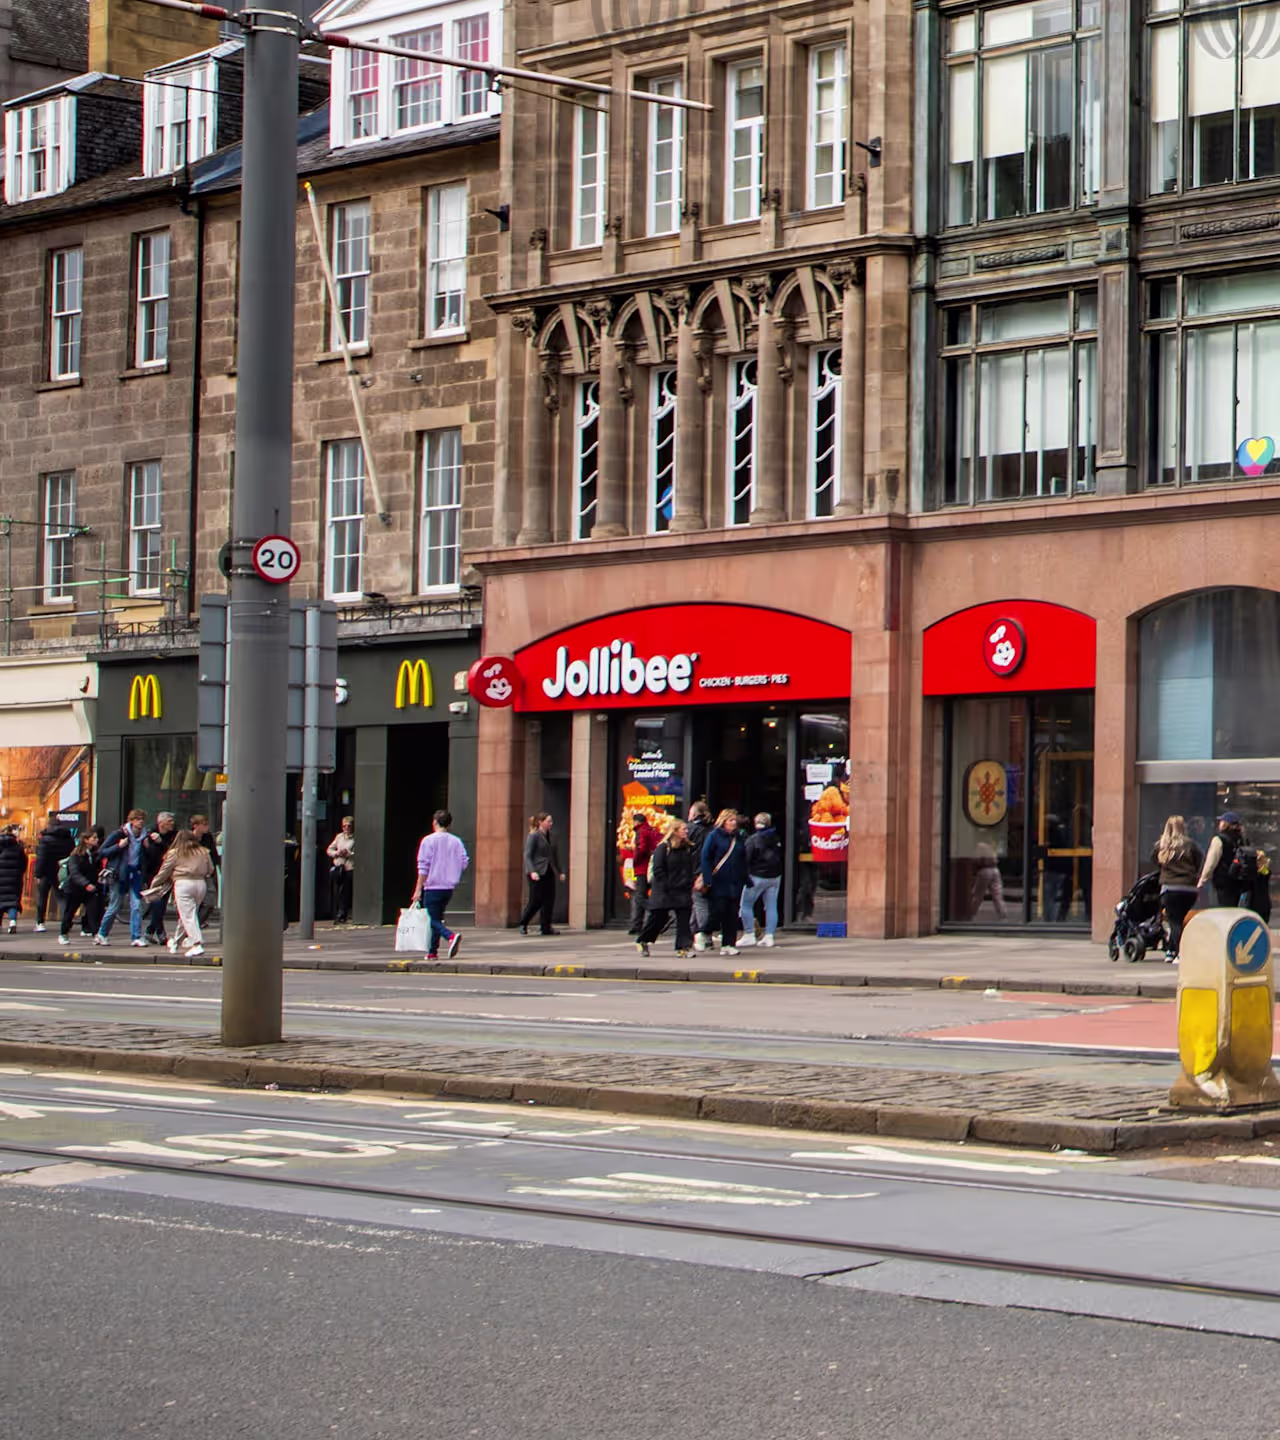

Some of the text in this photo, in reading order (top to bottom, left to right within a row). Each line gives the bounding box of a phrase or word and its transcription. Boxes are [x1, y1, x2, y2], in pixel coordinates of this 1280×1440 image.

[261, 549, 293, 569] 20
[542, 639, 694, 698] Jollibee
[699, 673, 788, 688] CHICKEN BURGERS PIES
[811, 835, 850, 849] Chickenjo
